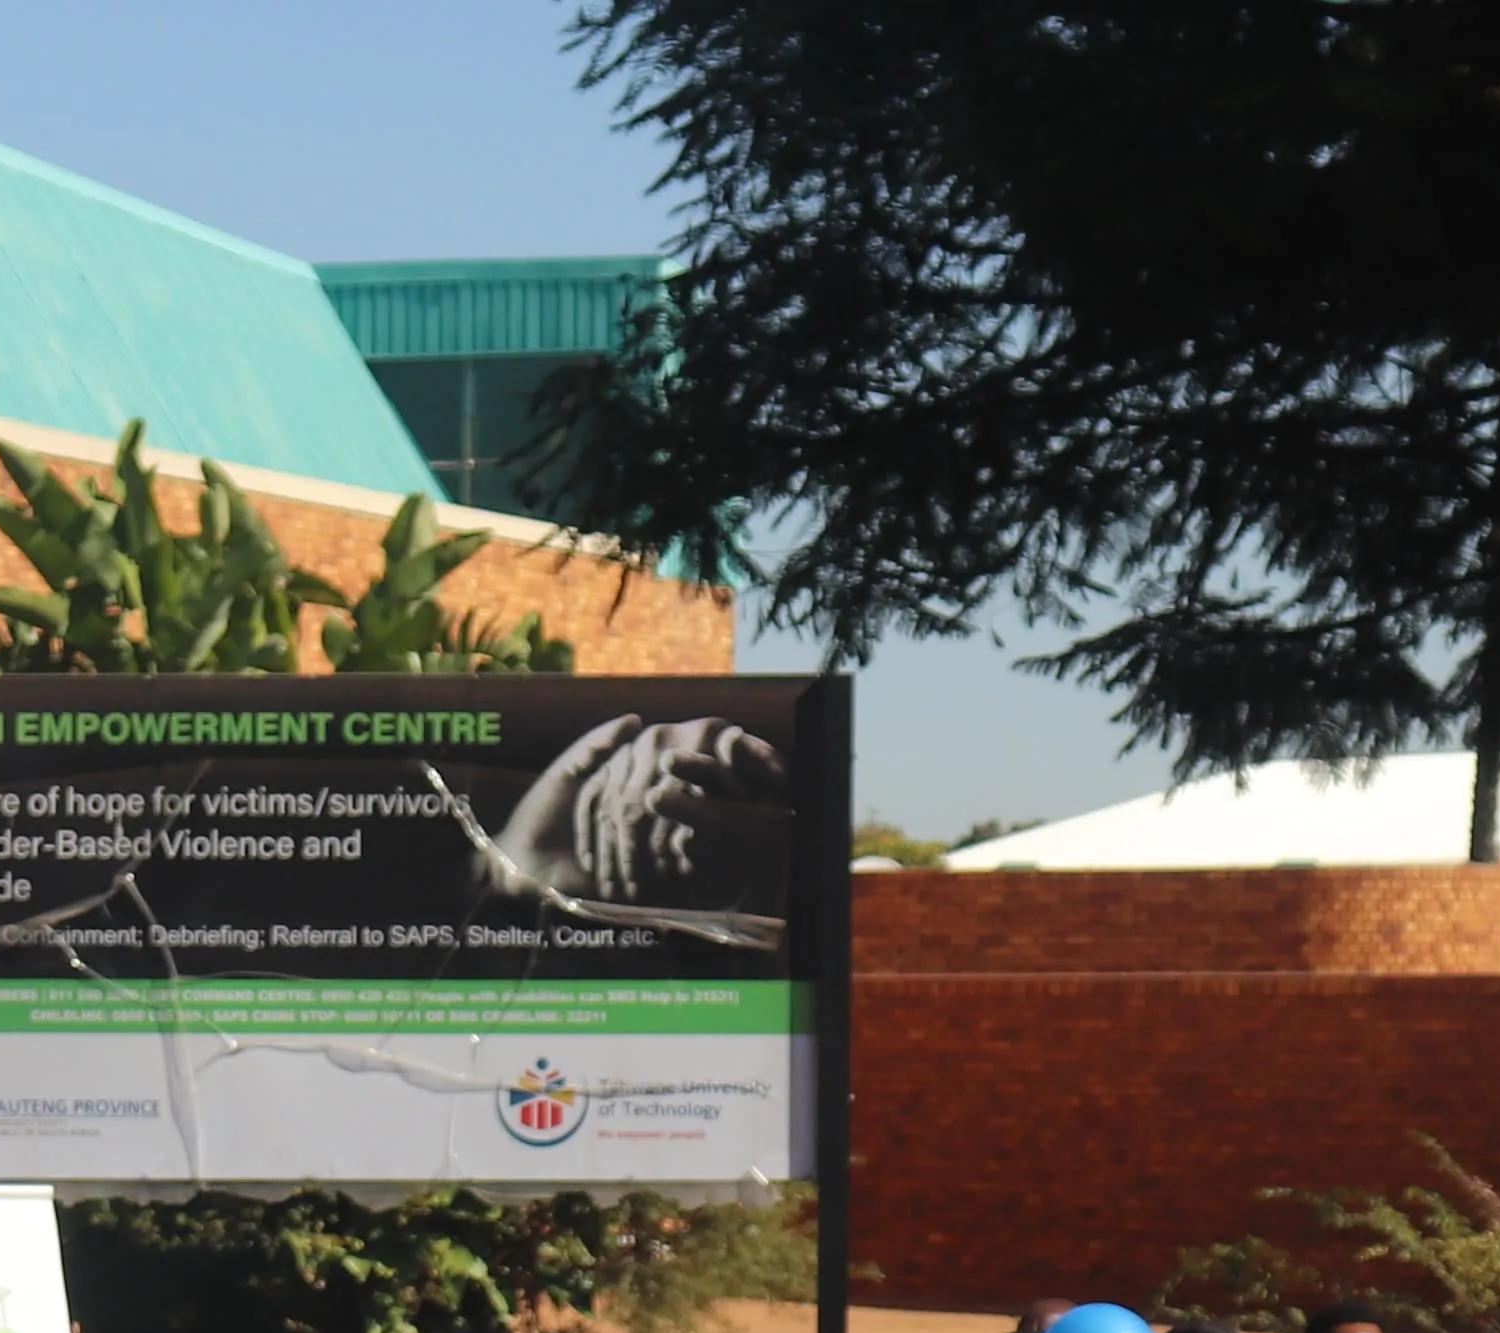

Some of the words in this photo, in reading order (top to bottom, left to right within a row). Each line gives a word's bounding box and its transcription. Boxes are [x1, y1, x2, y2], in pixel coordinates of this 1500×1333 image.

[15, 711, 334, 743] EMPOWERMENT
[341, 711, 501, 743] CENTRE
[27, 785, 59, 817] of
[65, 785, 145, 823] hope
[152, 785, 195, 816] for
[204, 786, 470, 817] victims/survivors
[162, 829, 294, 860] Violence
[302, 829, 361, 859] and
[151, 924, 266, 951] Debriefing;
[270, 924, 356, 946] Referral
[362, 927, 384, 946] to
[390, 924, 460, 948] SAPS,
[468, 924, 549, 947] Shelter,
[555, 924, 615, 946] Court
[620, 927, 659, 946] etc.
[74, 1099, 160, 1115] PROVINCE
[598, 1101, 616, 1117] of
[623, 1101, 722, 1120] Technology
